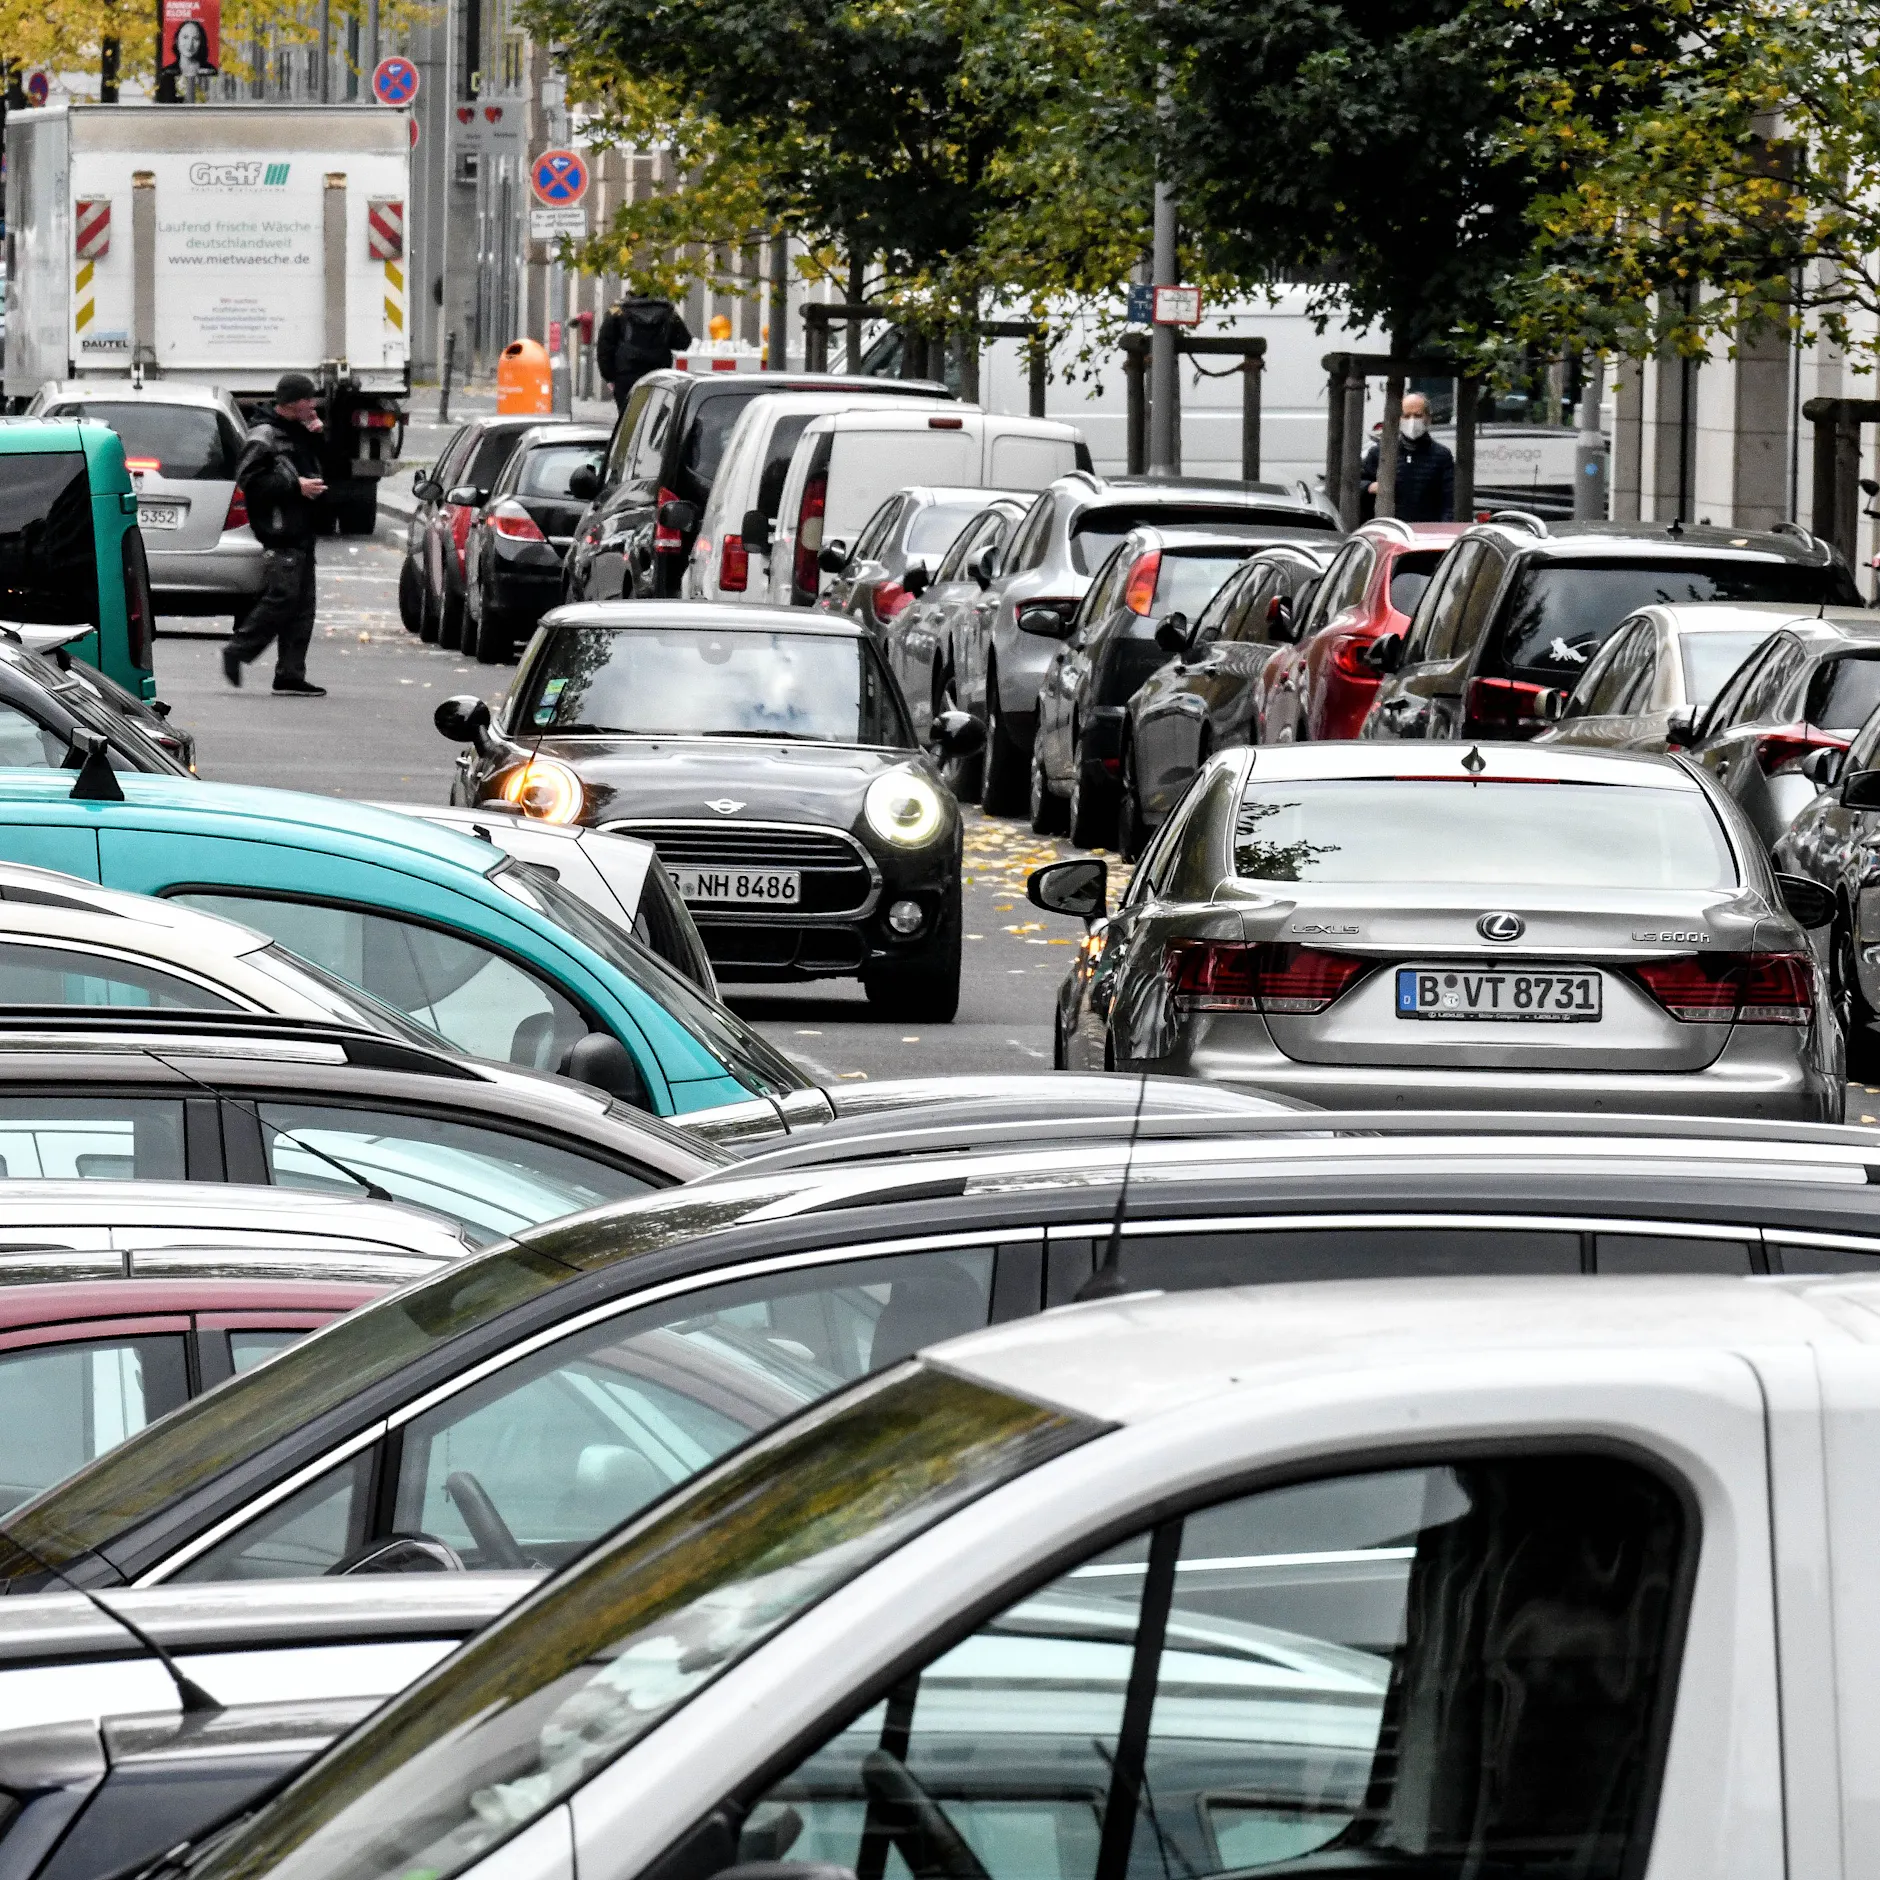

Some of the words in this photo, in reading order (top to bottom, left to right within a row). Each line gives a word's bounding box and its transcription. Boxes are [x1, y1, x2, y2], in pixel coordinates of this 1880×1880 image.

[189, 161, 262, 186] Greif
[158, 221, 211, 233] Laufend
[216, 221, 257, 233] frische
[262, 221, 311, 233] Wäsche
[186, 237, 292, 249] deutschlandweit
[168, 254, 310, 265] www.mietwaesche.de
[82, 340, 129, 348] DAUTEL
[140, 510, 175, 523] 5352
[697, 874, 729, 897] NH
[736, 875, 796, 899] 8486
[1291, 924, 1360, 934] LEXUS
[1659, 931, 1711, 943] 600h
[1419, 975, 1440, 1007] B
[1463, 976, 1506, 1008] VT
[1513, 977, 1595, 1010] 8731
